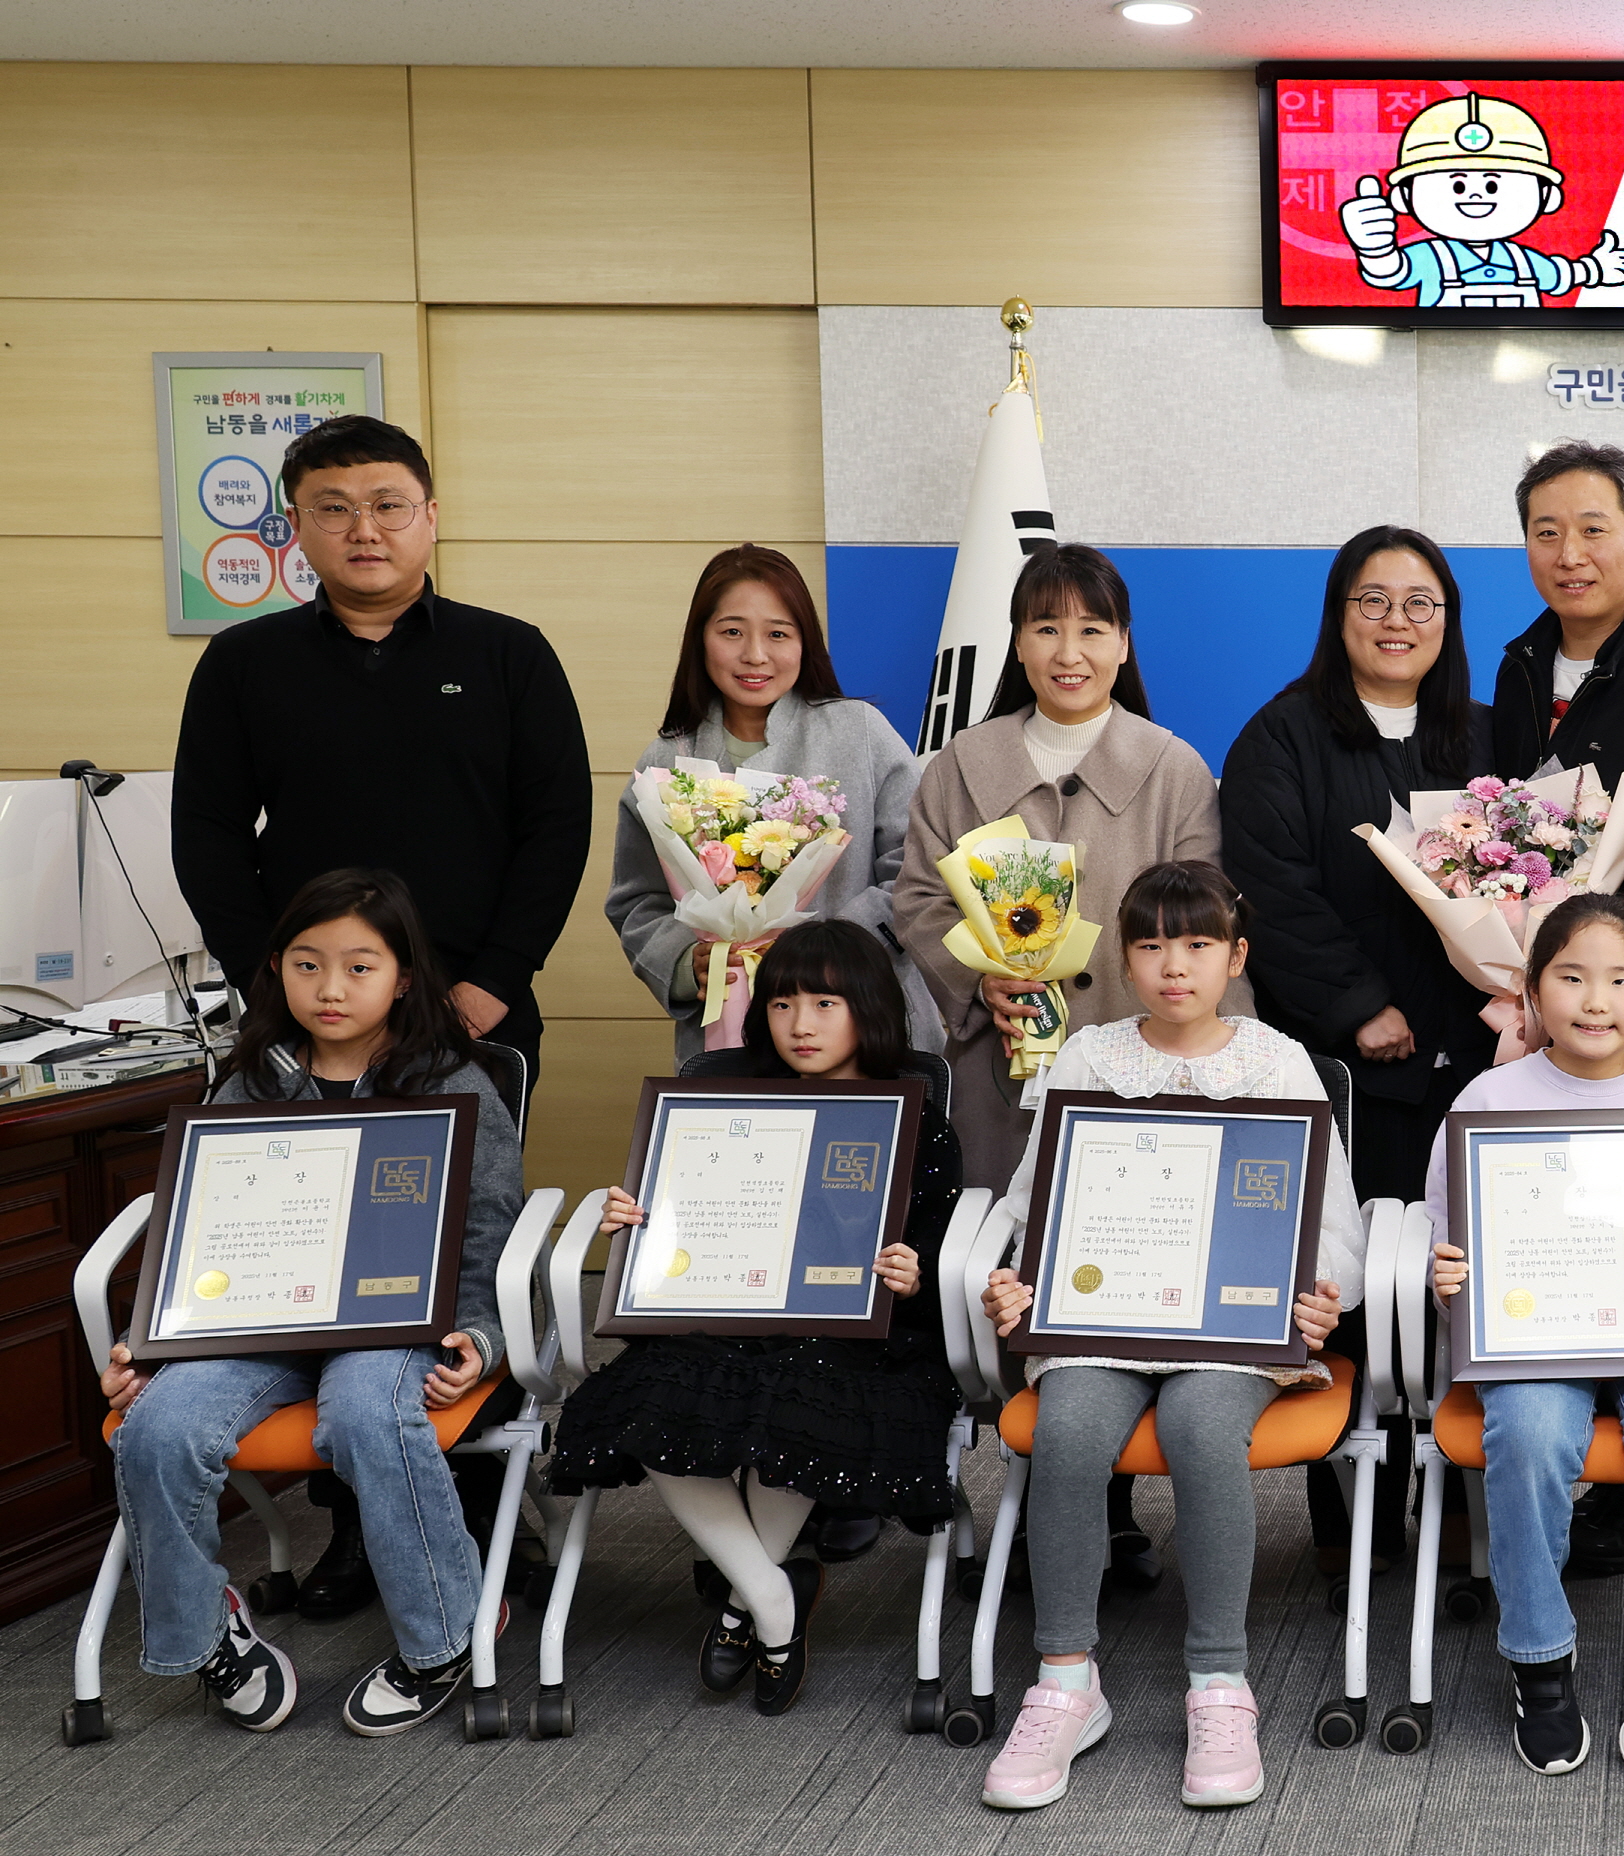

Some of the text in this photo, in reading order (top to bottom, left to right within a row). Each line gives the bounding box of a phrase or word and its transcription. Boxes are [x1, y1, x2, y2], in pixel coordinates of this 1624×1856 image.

[193, 389, 345, 406] 구민을 편하게 경제를 활기차게
[206, 414, 267, 435] 남동을
[219, 480, 250, 490] 배려와
[214, 494, 256, 506] 참여복지
[265, 520, 284, 530] 구정
[266, 531, 285, 542] 목표
[217, 558, 260, 571] 역동적인
[218, 573, 260, 585] 지역경제
[706, 1151, 765, 1163] 상 장
[242, 1171, 307, 1186] 상 장
[1114, 1166, 1173, 1180] 상 장
[1528, 1187, 1541, 1200] 상
